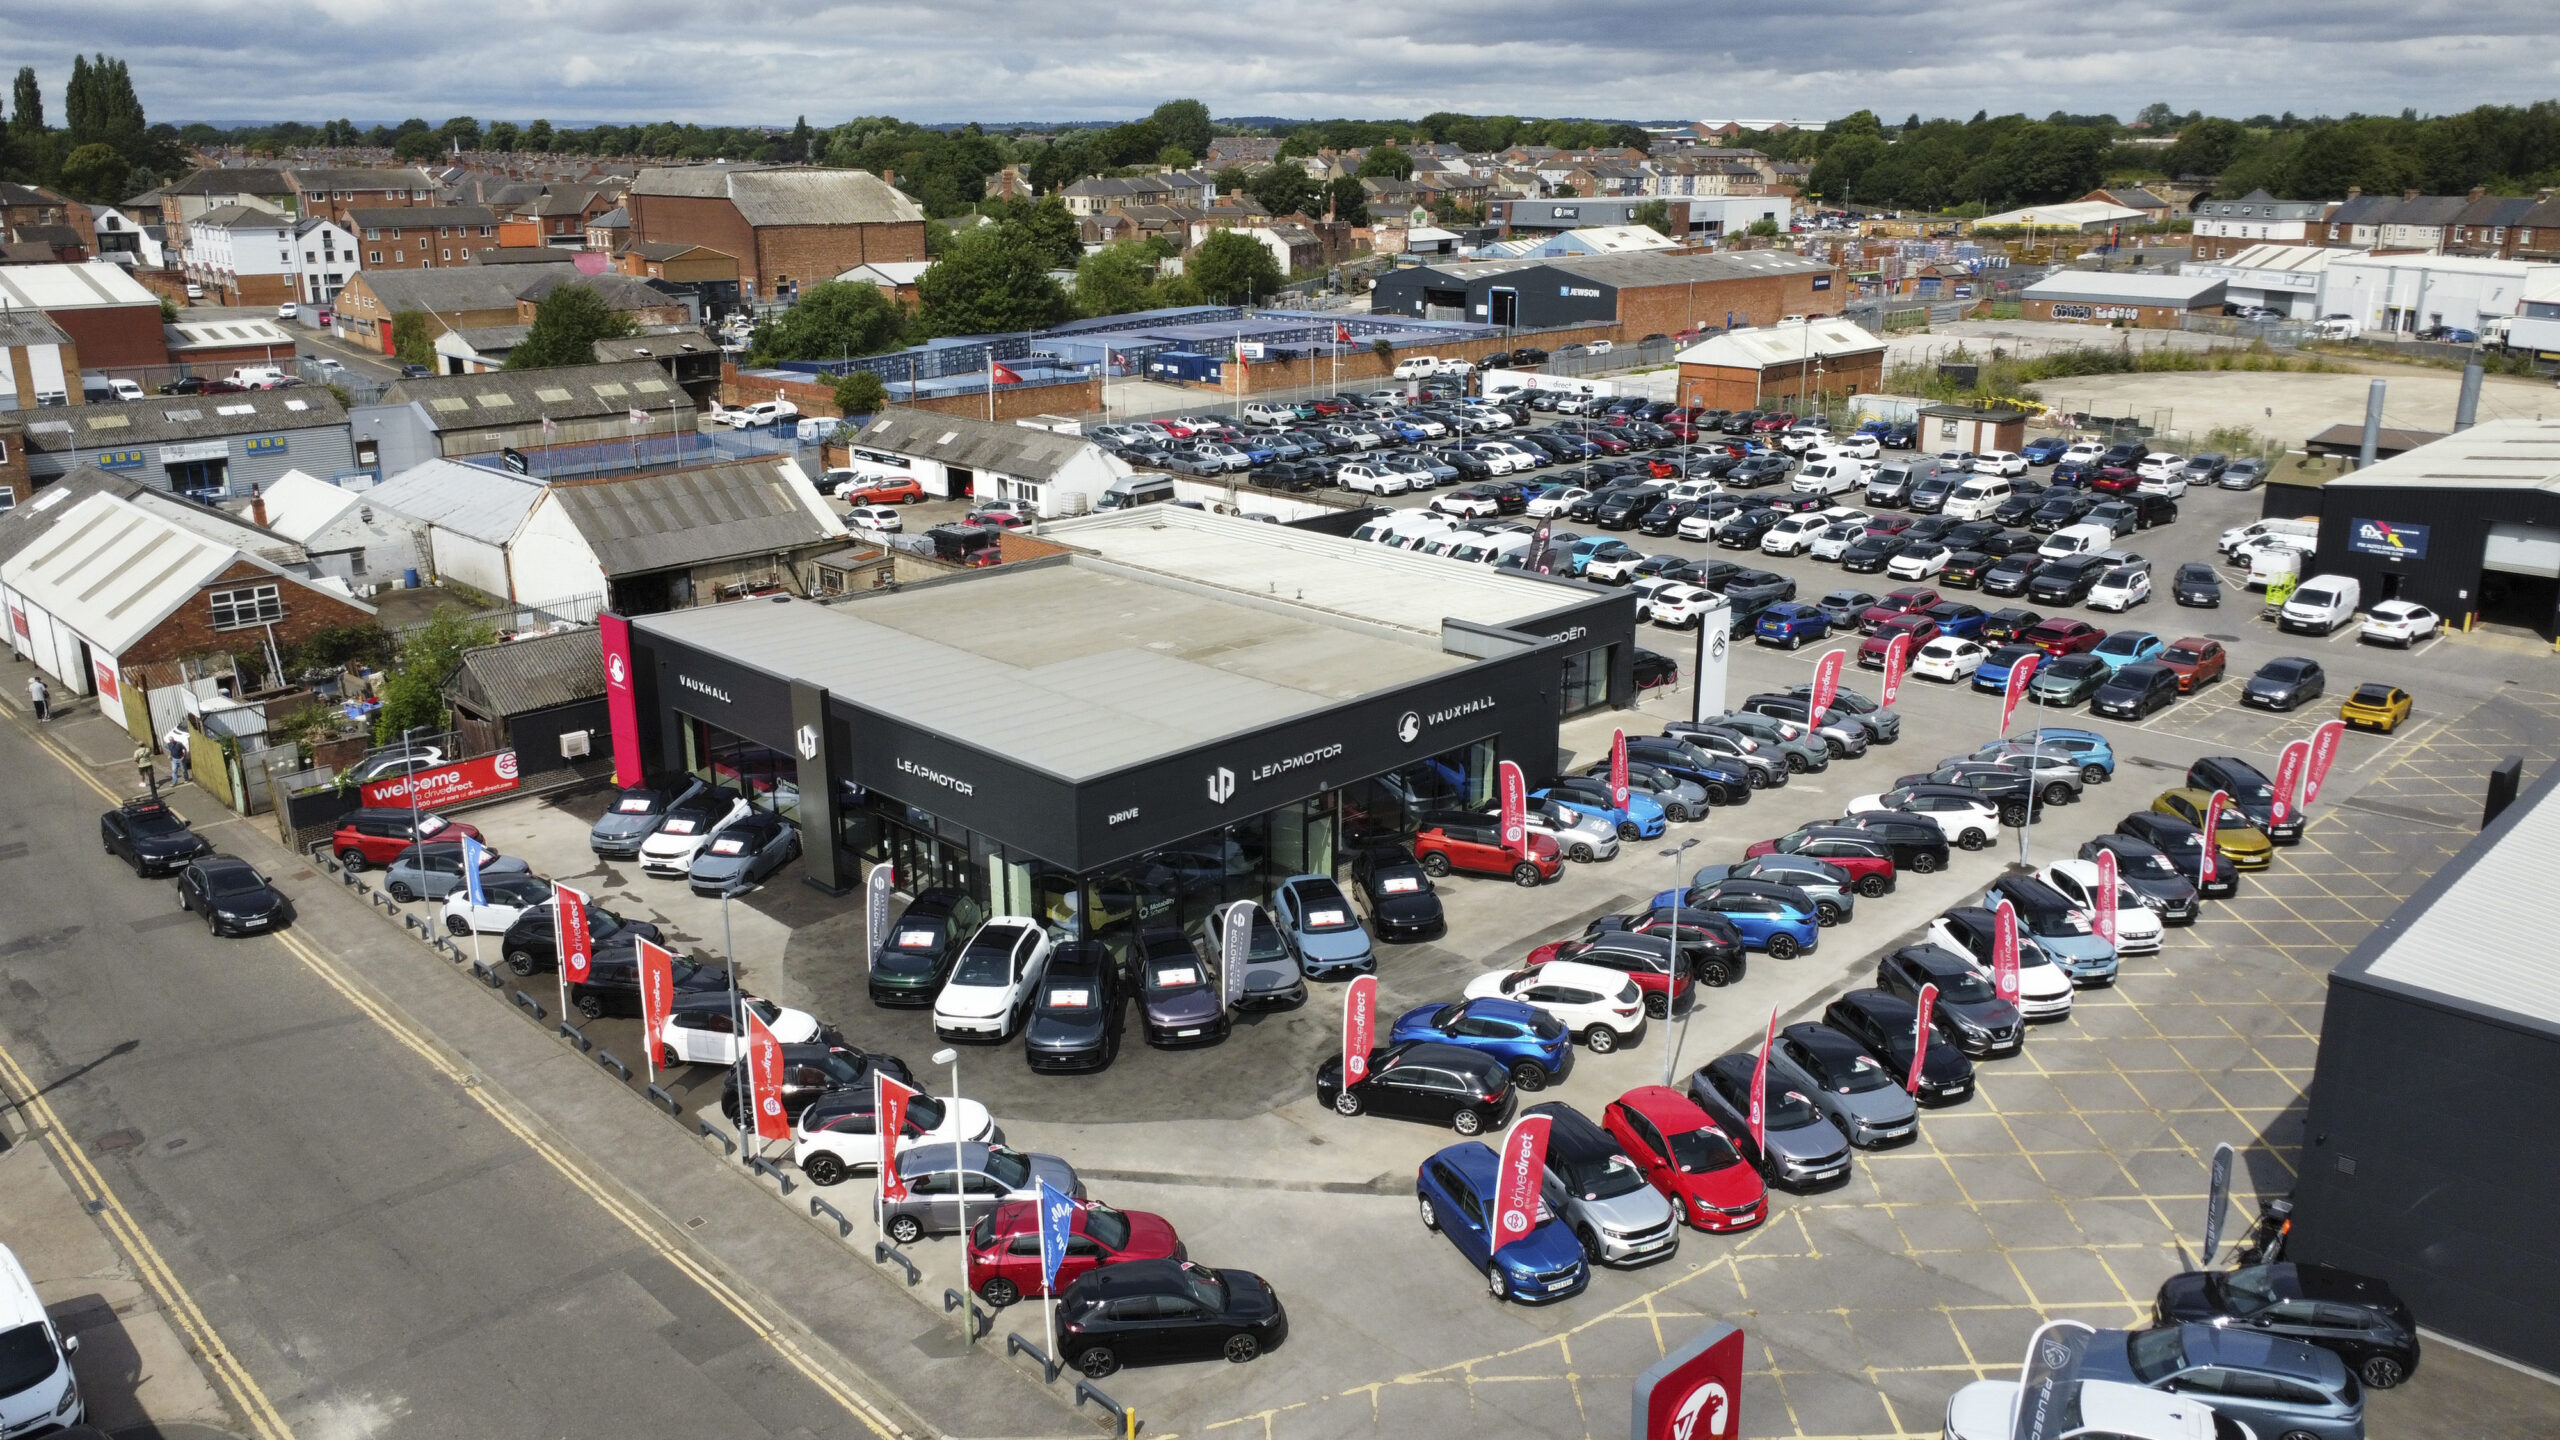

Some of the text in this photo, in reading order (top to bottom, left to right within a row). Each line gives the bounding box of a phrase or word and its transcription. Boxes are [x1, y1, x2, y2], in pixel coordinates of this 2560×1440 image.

[1570, 288, 1600, 298] JEWSON
[1546, 626, 1587, 643] ROËN
[680, 674, 732, 703] VAUXHALL
[1428, 696, 1496, 726] VAUXHALL
[1252, 743, 1343, 781] LEAPMOTOR
[373, 771, 460, 800] welcome
[424, 780, 473, 799] drivedirect
[897, 757, 973, 797] LEAPMOTOR
[1108, 807, 1139, 826] DRIVE
[1149, 897, 1175, 910] Motability
[569, 899, 583, 951] drivedirect
[1356, 990, 1367, 1055] drivedirect
[1510, 1132, 1534, 1208] drivedirect
[2031, 1376, 2053, 1440] PEUGEO
